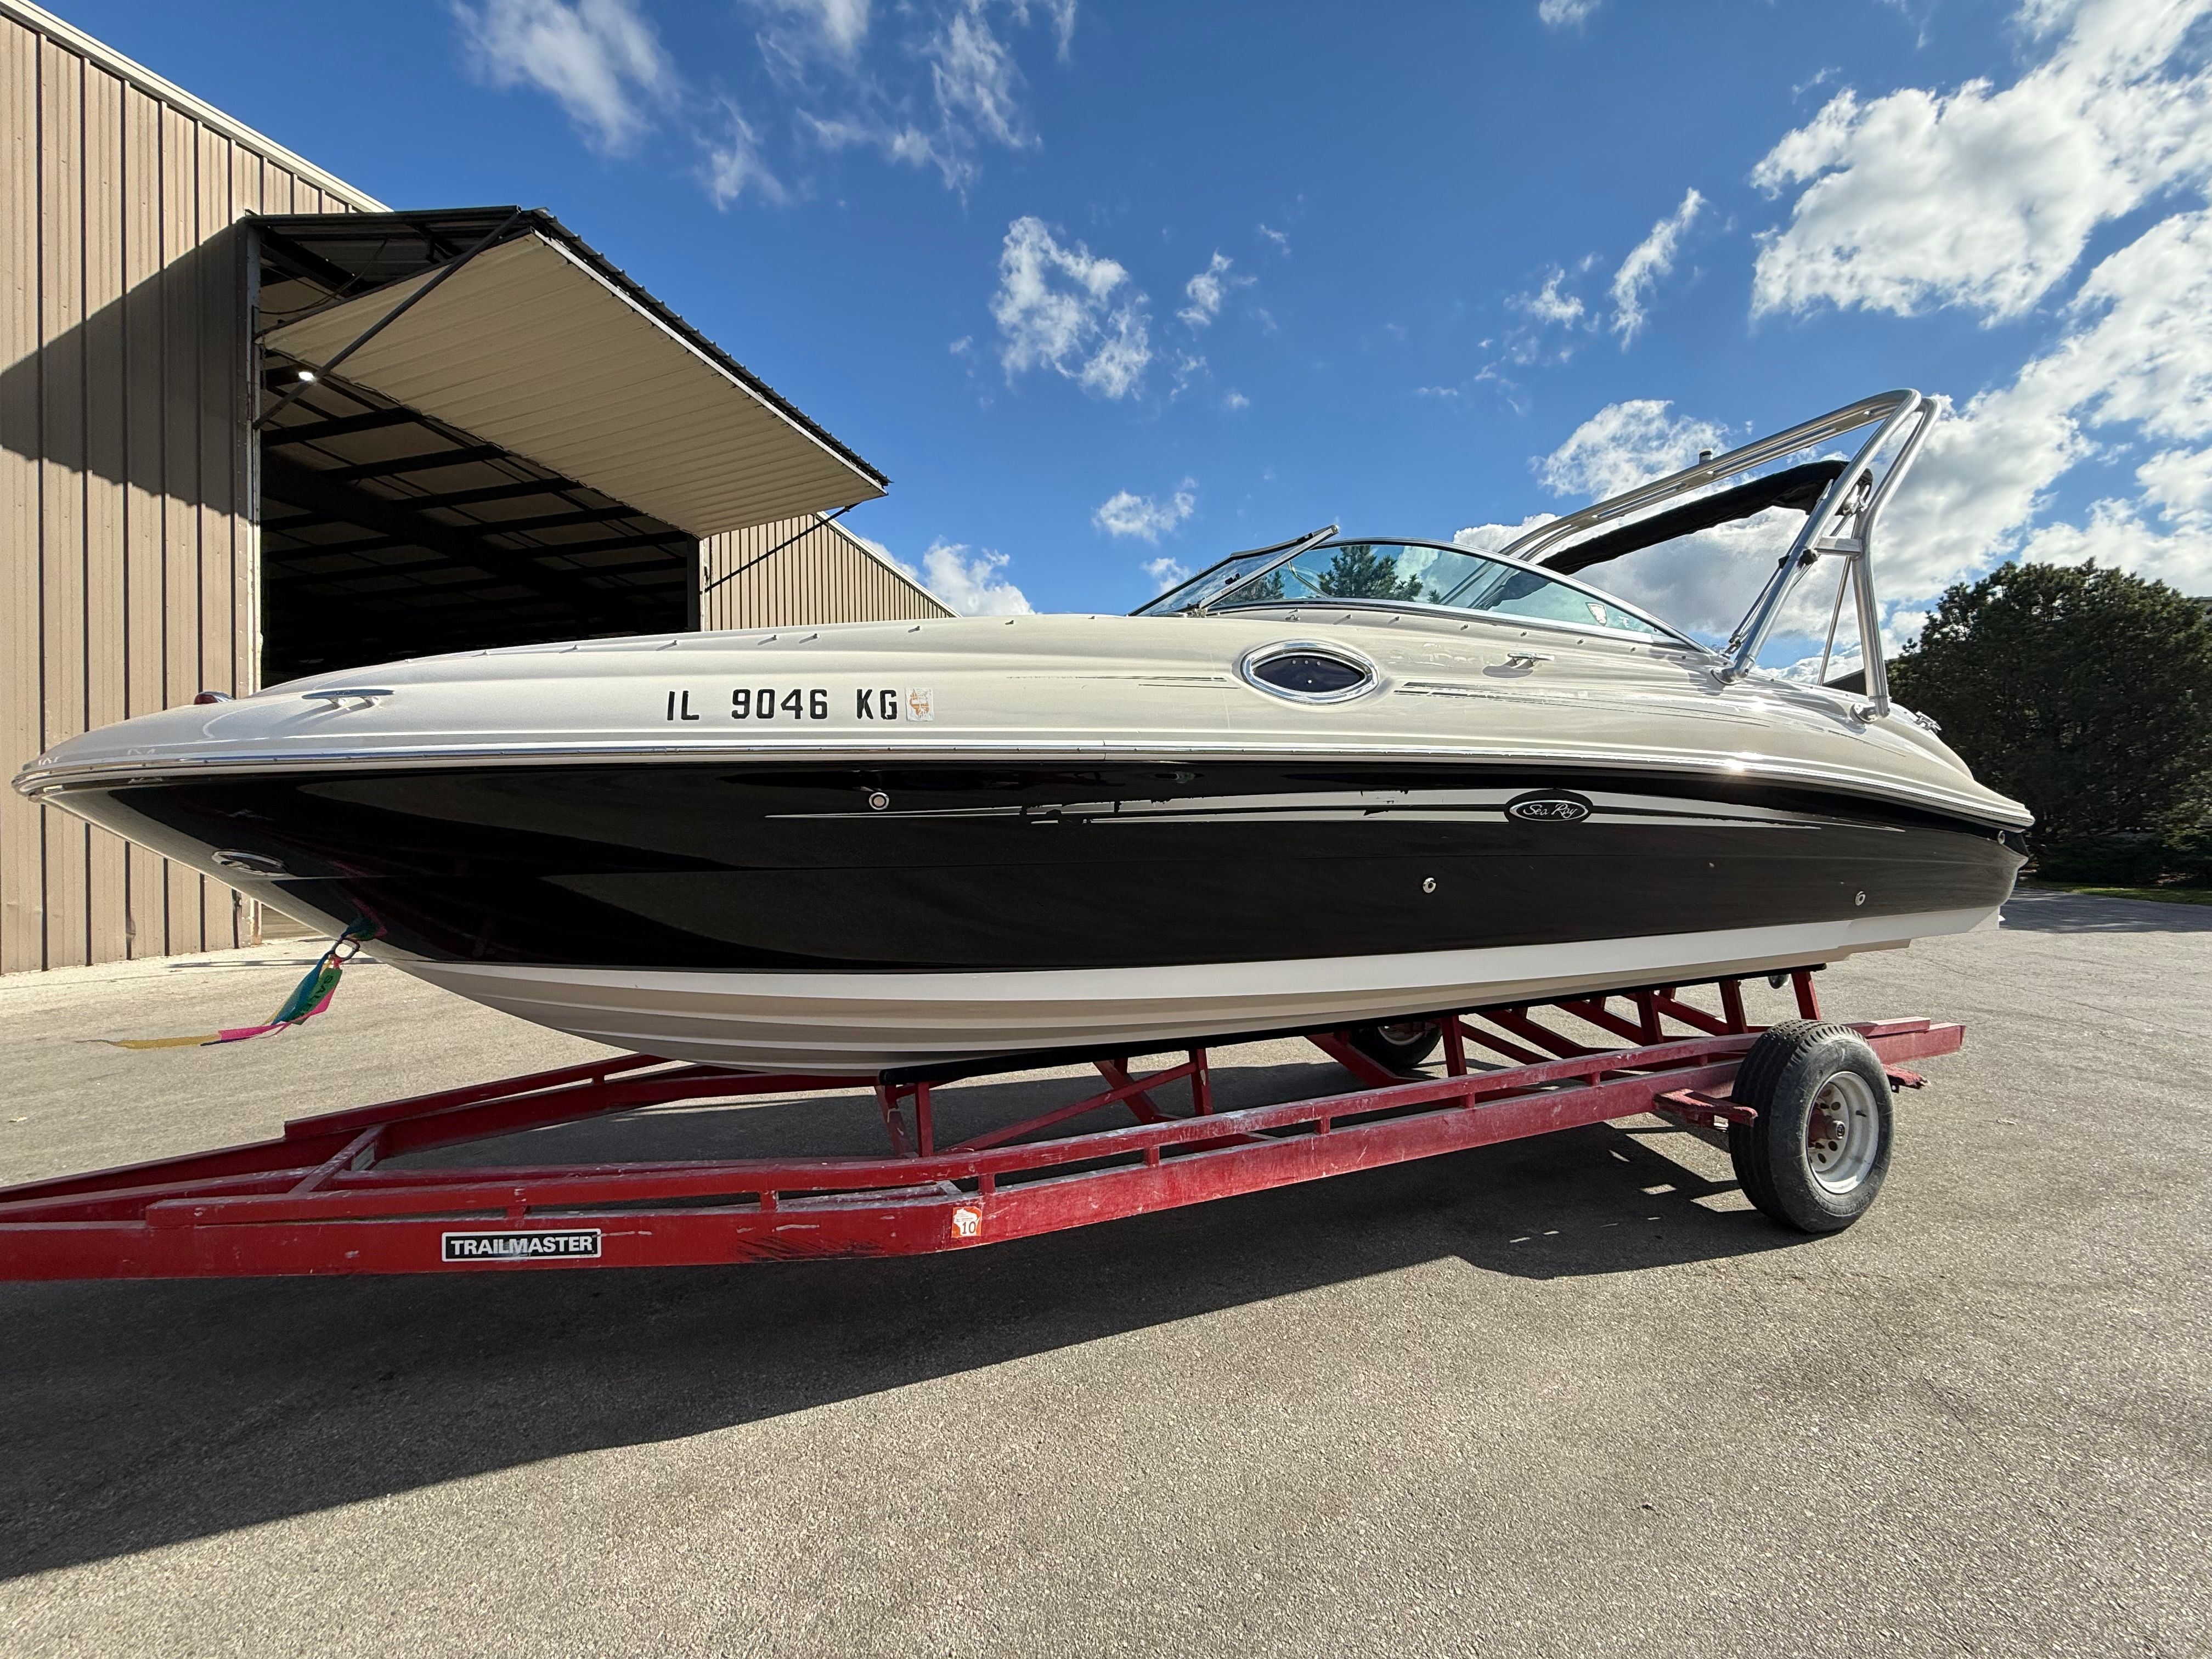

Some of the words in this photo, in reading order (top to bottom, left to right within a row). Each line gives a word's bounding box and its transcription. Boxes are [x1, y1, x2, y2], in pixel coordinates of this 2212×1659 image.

[667, 690, 699, 721] IL
[731, 689, 827, 720] 9046
[856, 689, 898, 720] KG
[1523, 804, 1549, 815] Sea
[1551, 803, 1578, 819] Ray
[962, 1221, 976, 1234] 10
[450, 1236, 593, 1255] TRAILMASTER
